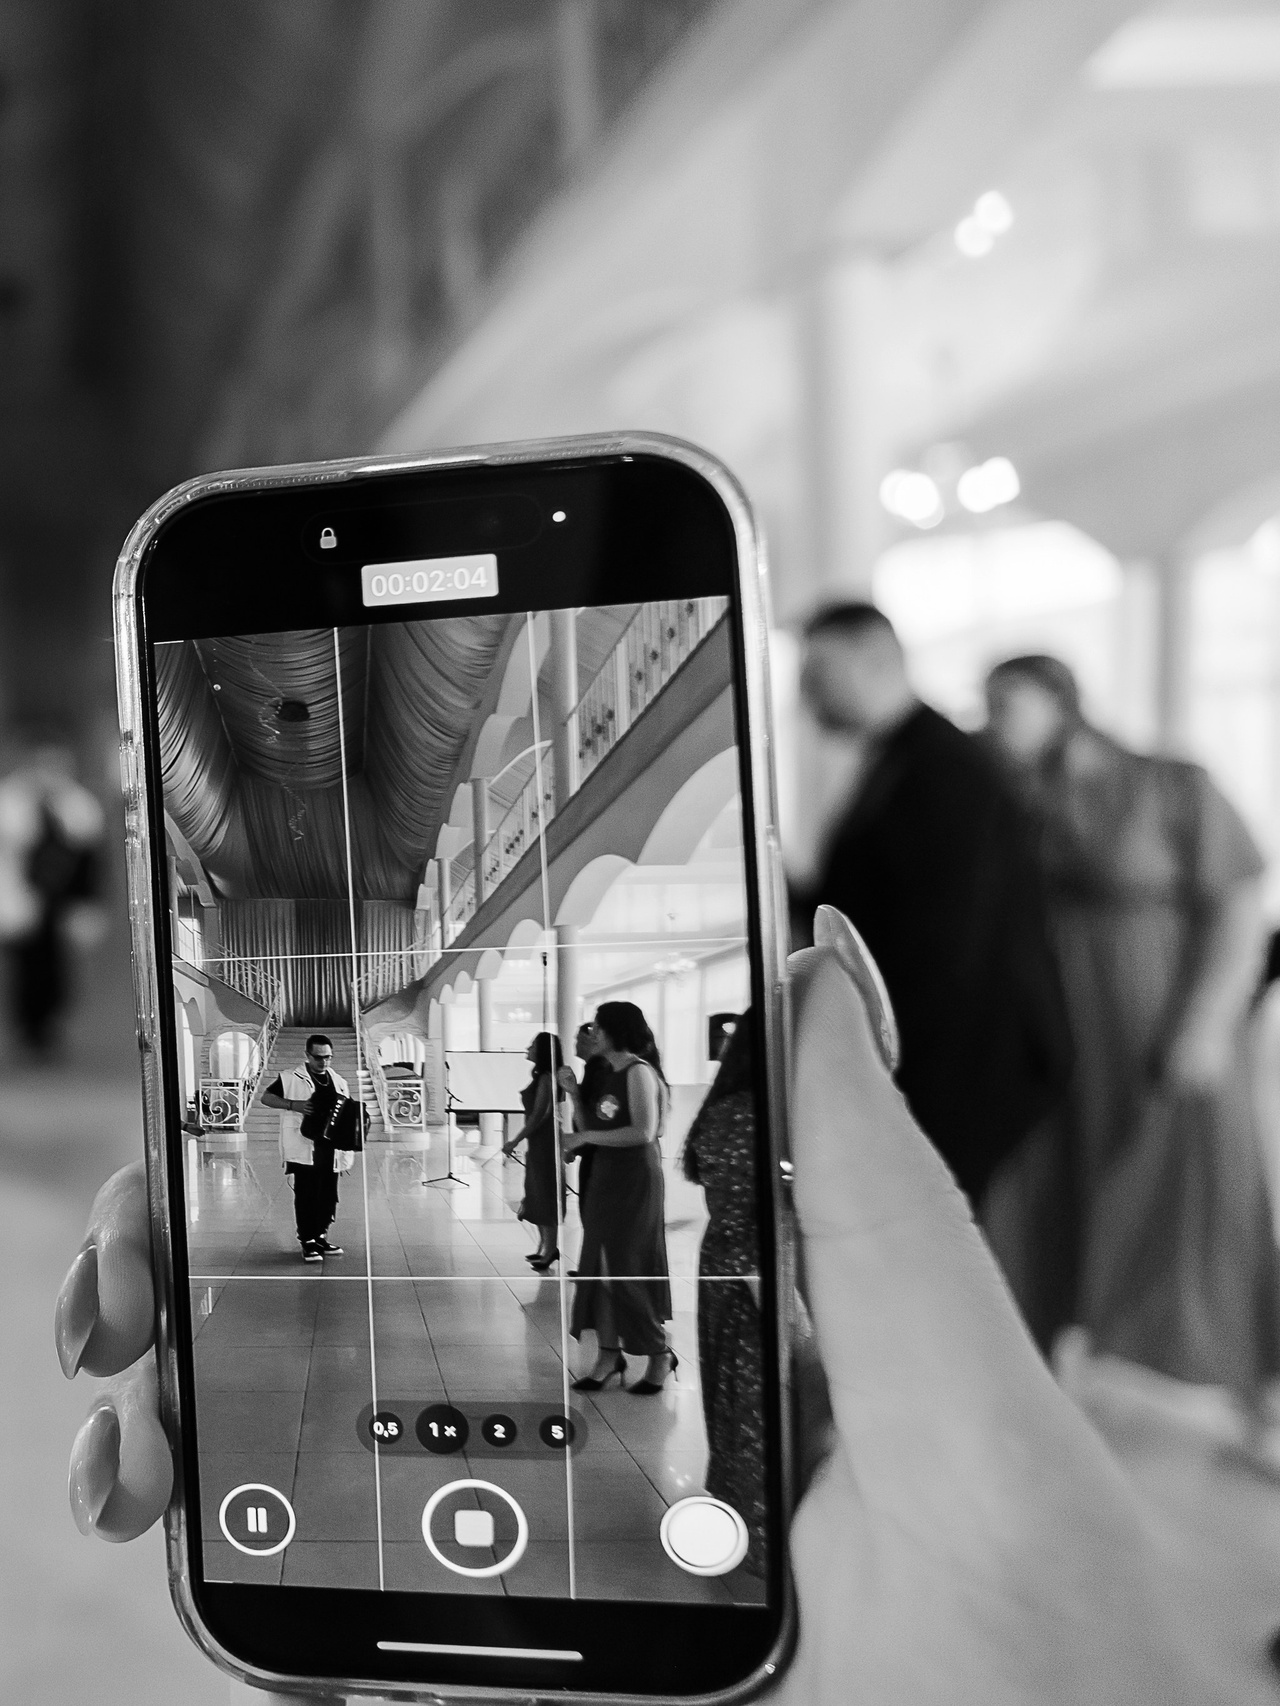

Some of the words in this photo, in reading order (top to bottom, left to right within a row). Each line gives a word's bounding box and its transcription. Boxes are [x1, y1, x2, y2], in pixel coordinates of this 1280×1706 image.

[371, 566, 489, 597] 00:02:04
[493, 1423, 506, 1439] 2
[550, 1425, 565, 1440] 5
